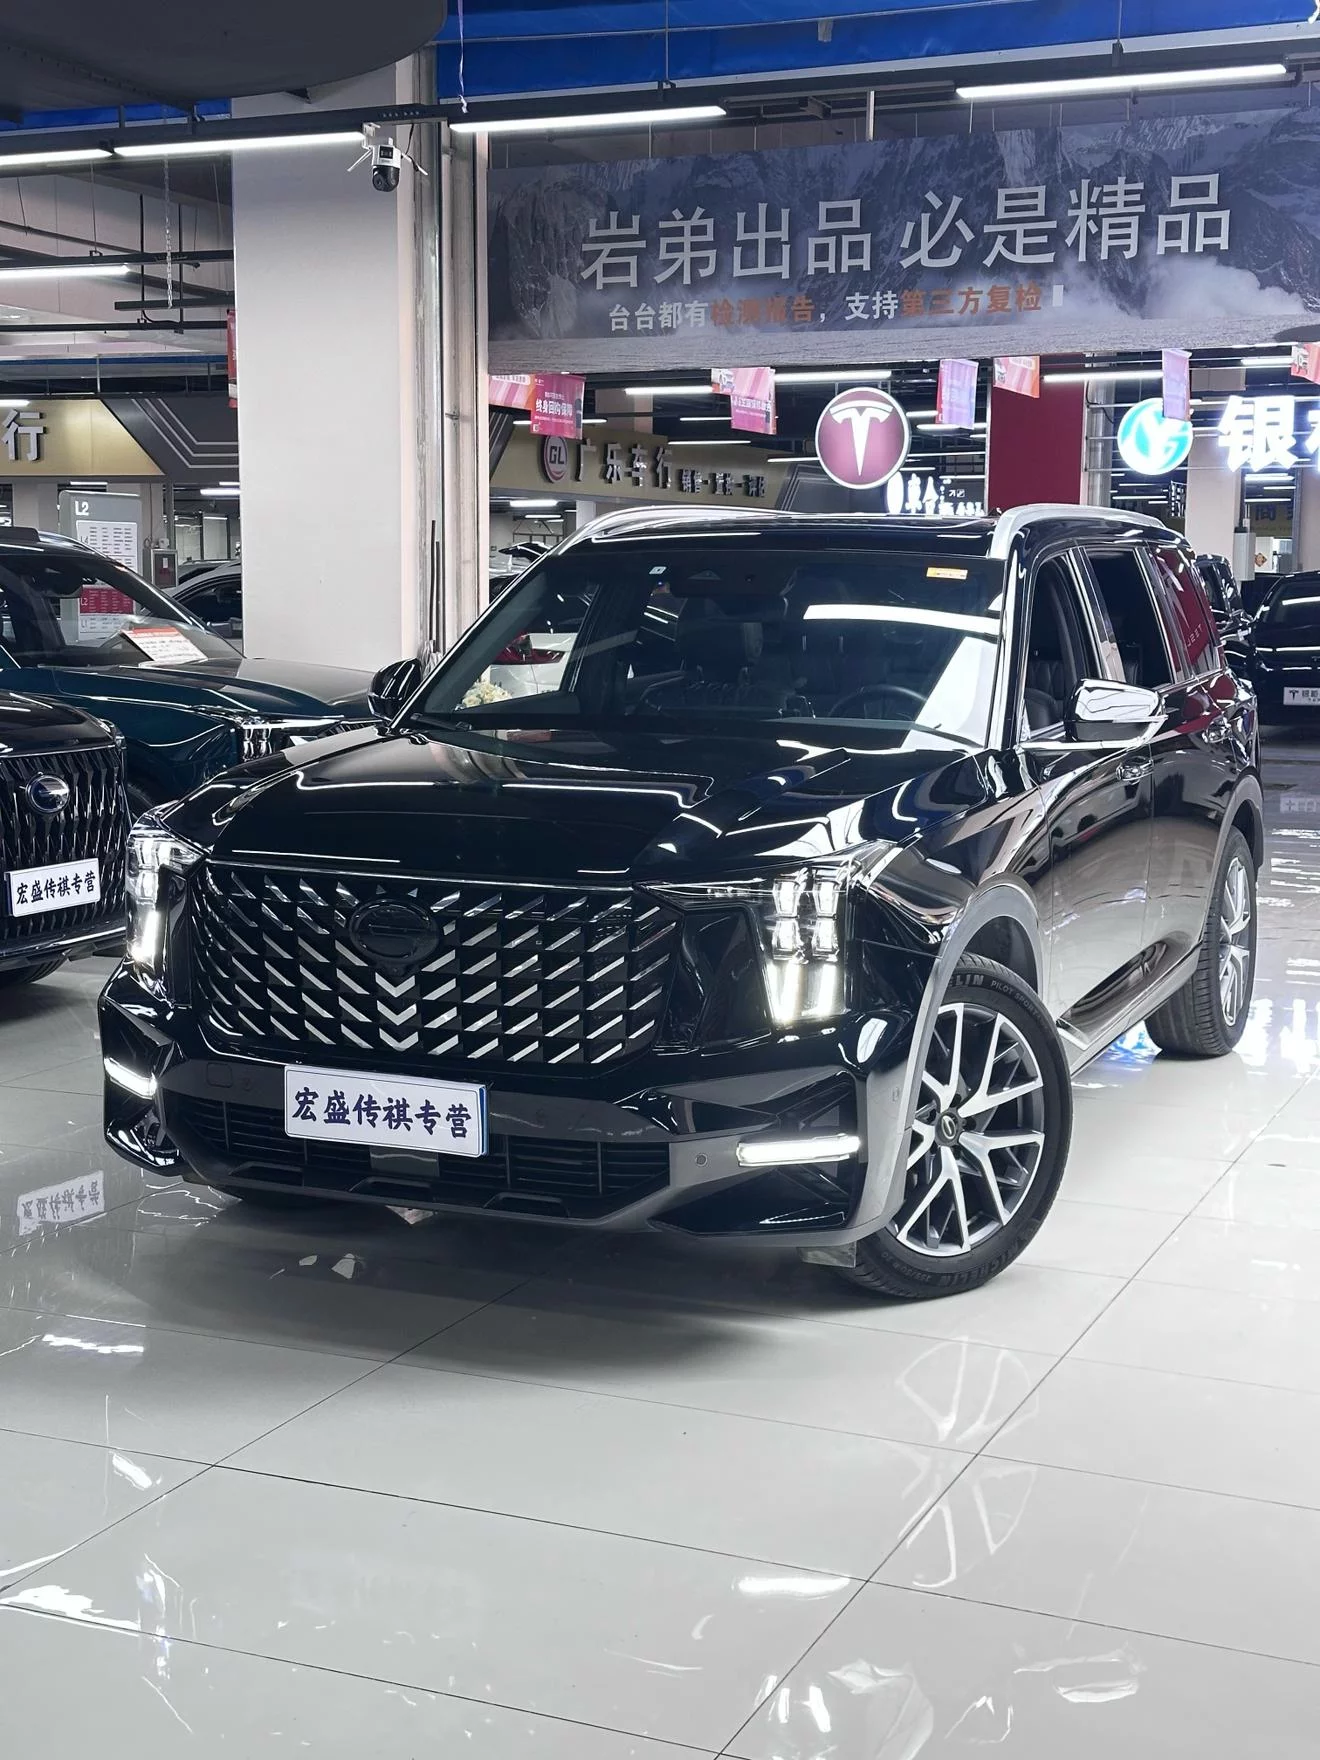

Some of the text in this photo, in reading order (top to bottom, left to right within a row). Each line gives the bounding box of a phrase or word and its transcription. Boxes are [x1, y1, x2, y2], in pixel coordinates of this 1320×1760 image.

[581, 173, 1231, 290] 岩弟出品 必是精品
[1, 409, 45, 461] 行
[549, 446, 565, 465] GL
[75, 500, 90, 516] L2
[16, 870, 96, 905] 宏盛传祺专营
[291, 1086, 473, 1139] 宏盛传祺专营
